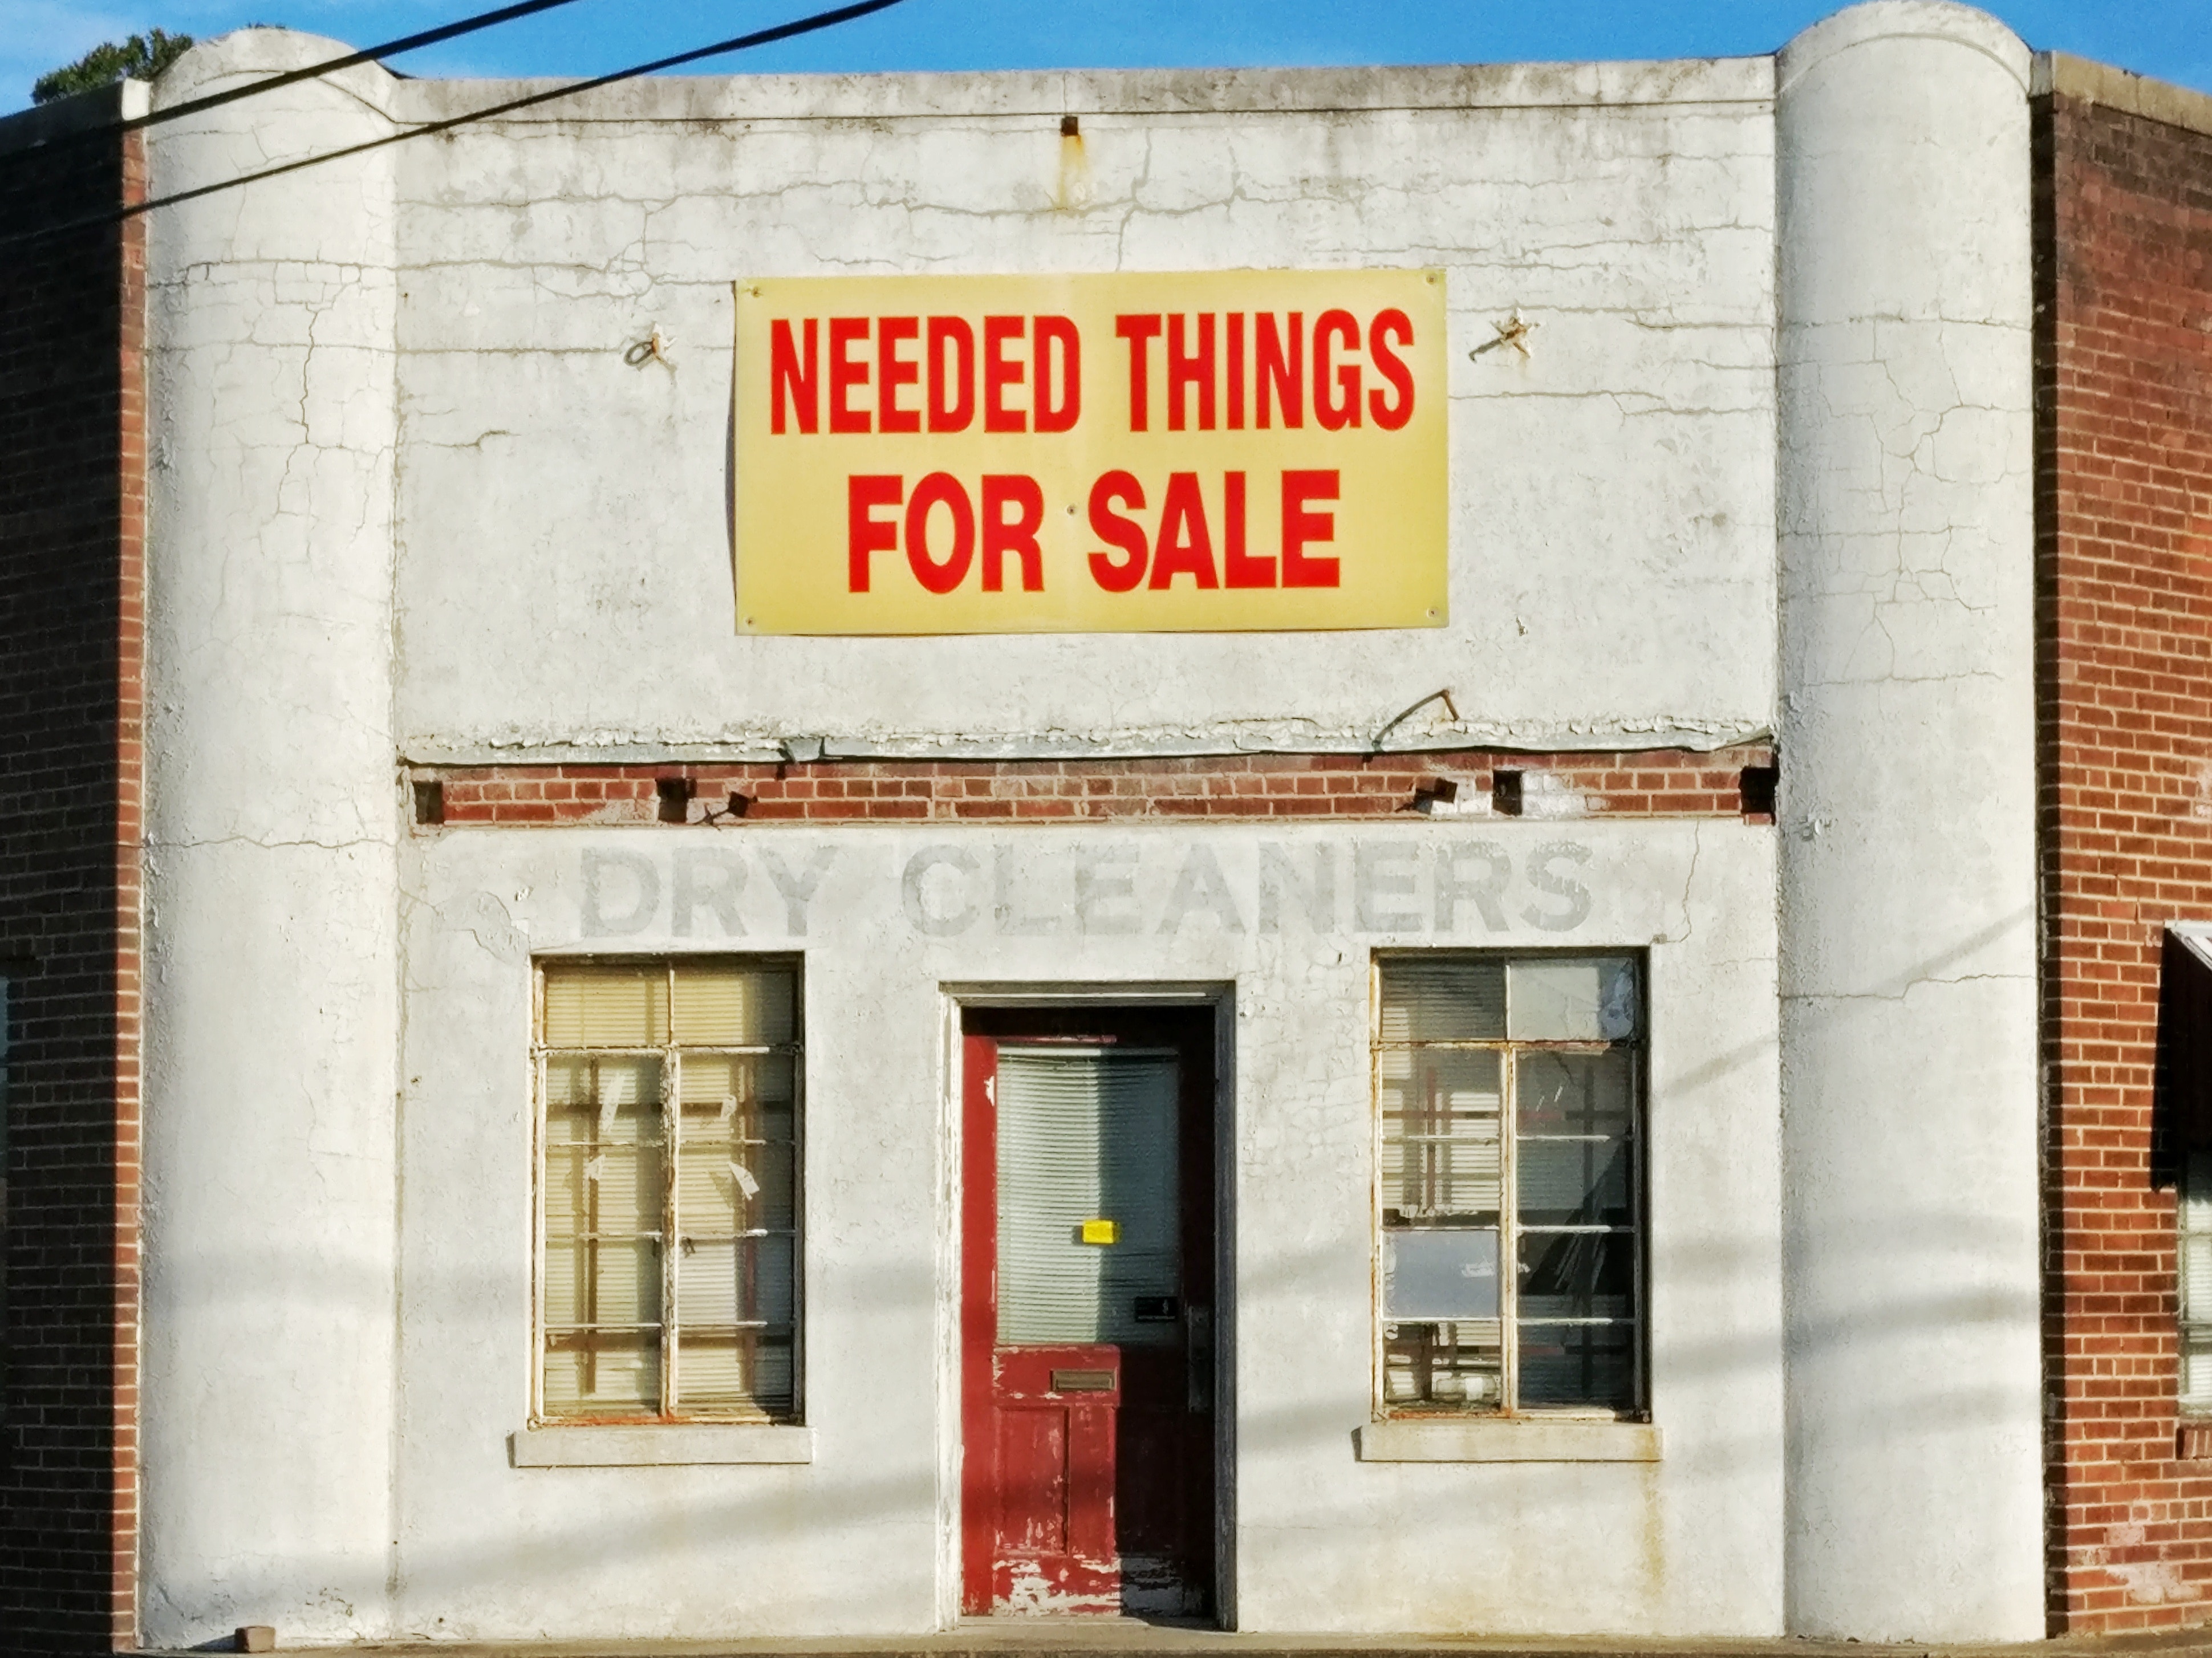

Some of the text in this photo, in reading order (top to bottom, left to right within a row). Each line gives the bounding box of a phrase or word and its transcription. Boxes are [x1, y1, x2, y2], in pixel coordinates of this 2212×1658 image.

[771, 308, 1415, 435] NEEDED THINGS
[849, 469, 1340, 594] FOR SALE
[581, 840, 1593, 937] DRY CLEANERS
